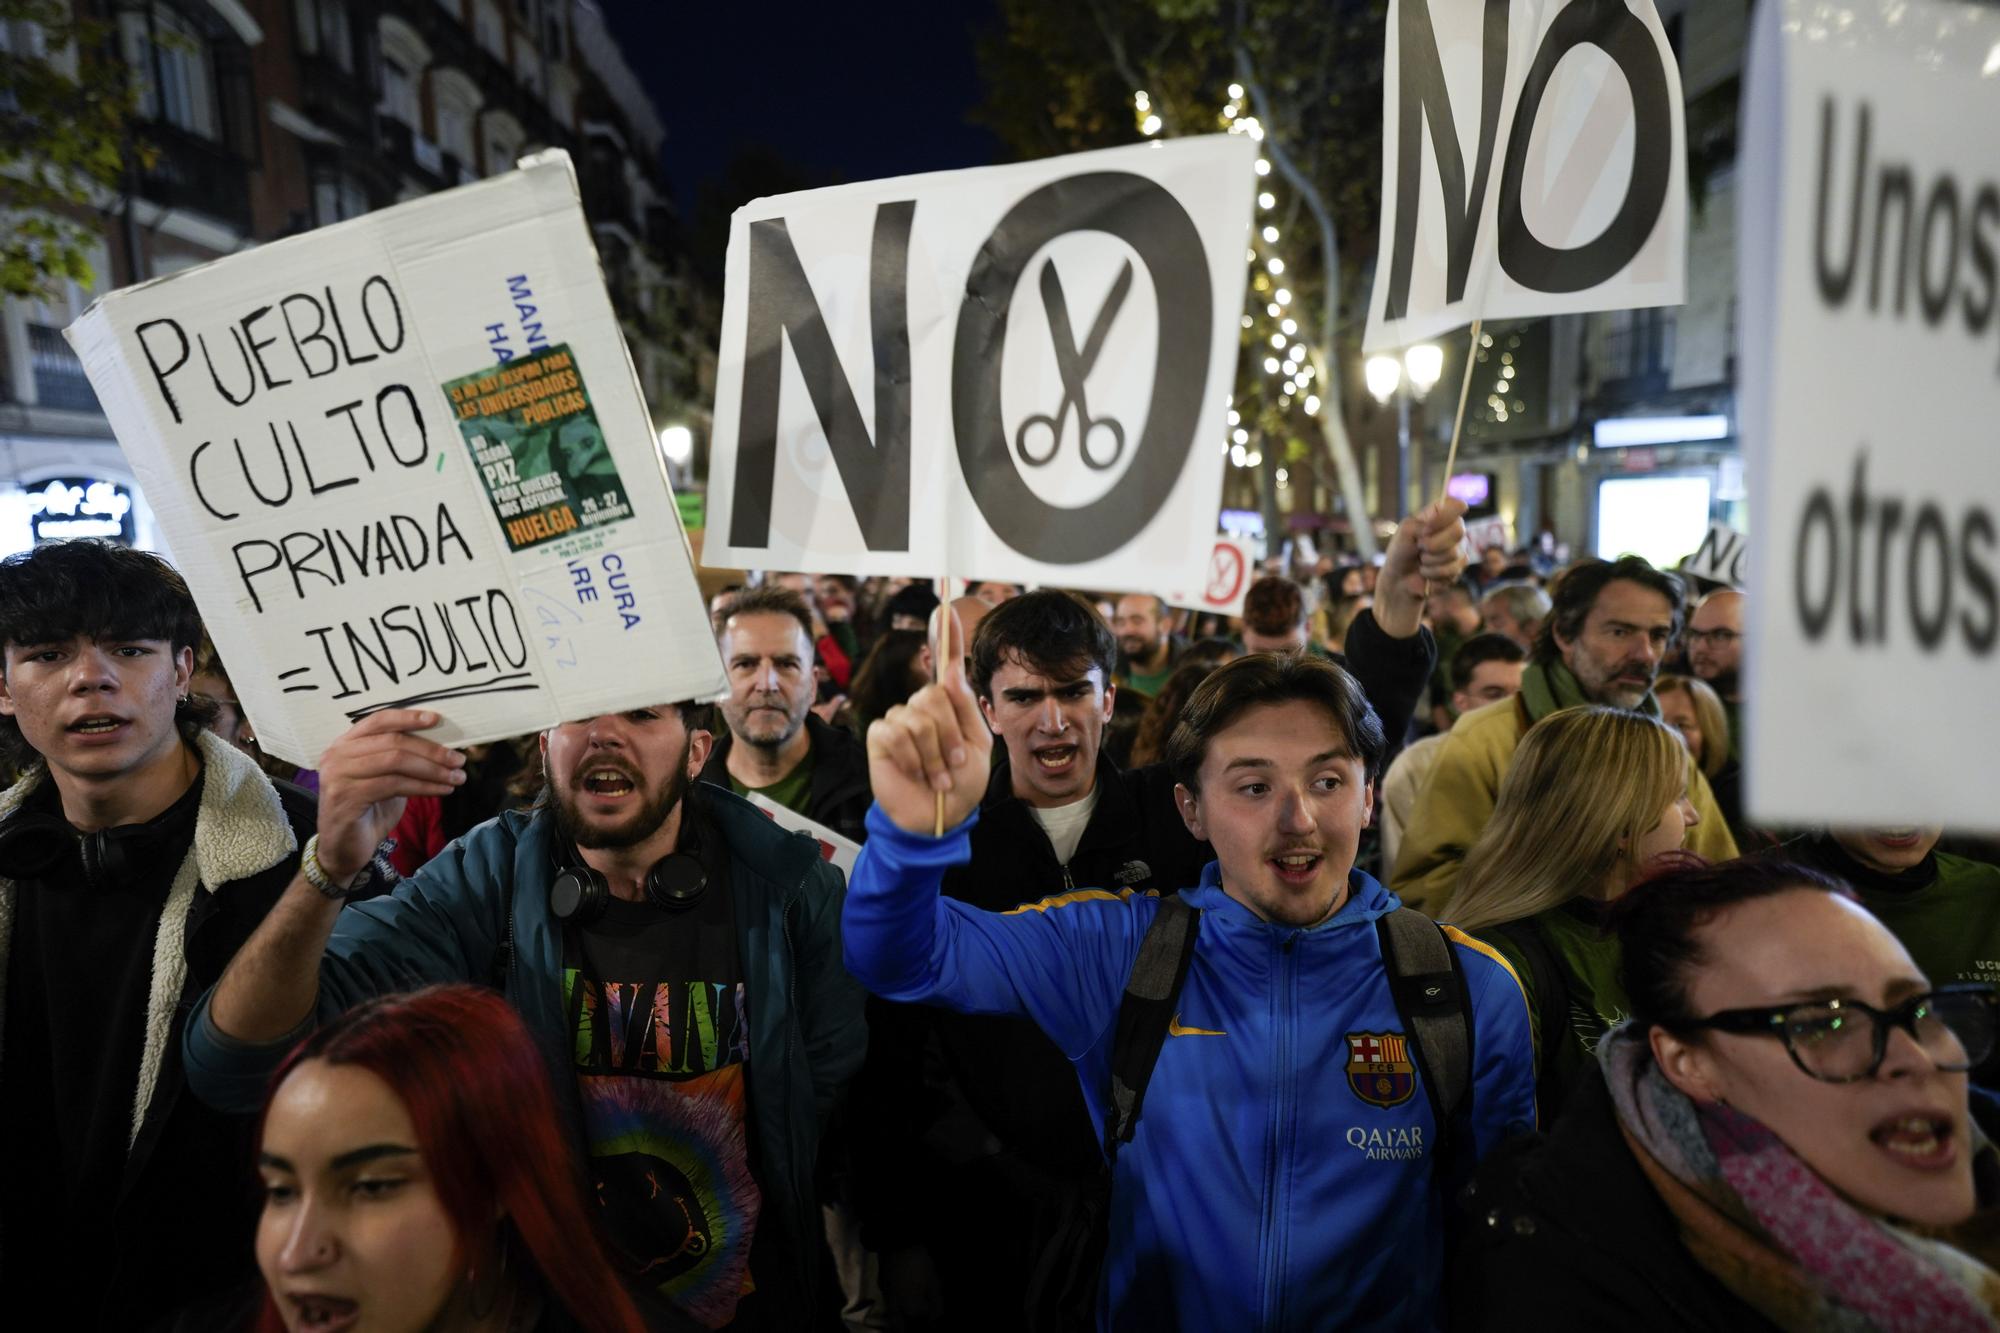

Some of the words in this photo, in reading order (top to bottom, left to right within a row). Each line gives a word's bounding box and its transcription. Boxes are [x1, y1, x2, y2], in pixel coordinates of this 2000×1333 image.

[1384, 0, 1672, 322] NO
[134, 274, 406, 425] PUEBLO
[542, 351, 572, 373] PARA
[728, 169, 1214, 566] NO
[456, 401, 479, 419] LAS
[479, 368, 578, 416] UNIVERSIDADES
[482, 458, 521, 489] PAZ
[603, 490, 618, 506] 27
[506, 504, 578, 546] HUELGA
[232, 502, 474, 614] PRIVADA
[1793, 445, 2000, 658] otros
[601, 554, 641, 631] CURA
[1368, 1063, 1395, 1073] FCB
[1346, 1127, 1423, 1150] QATAR
[1365, 1145, 1423, 1161] AIRWAYS
